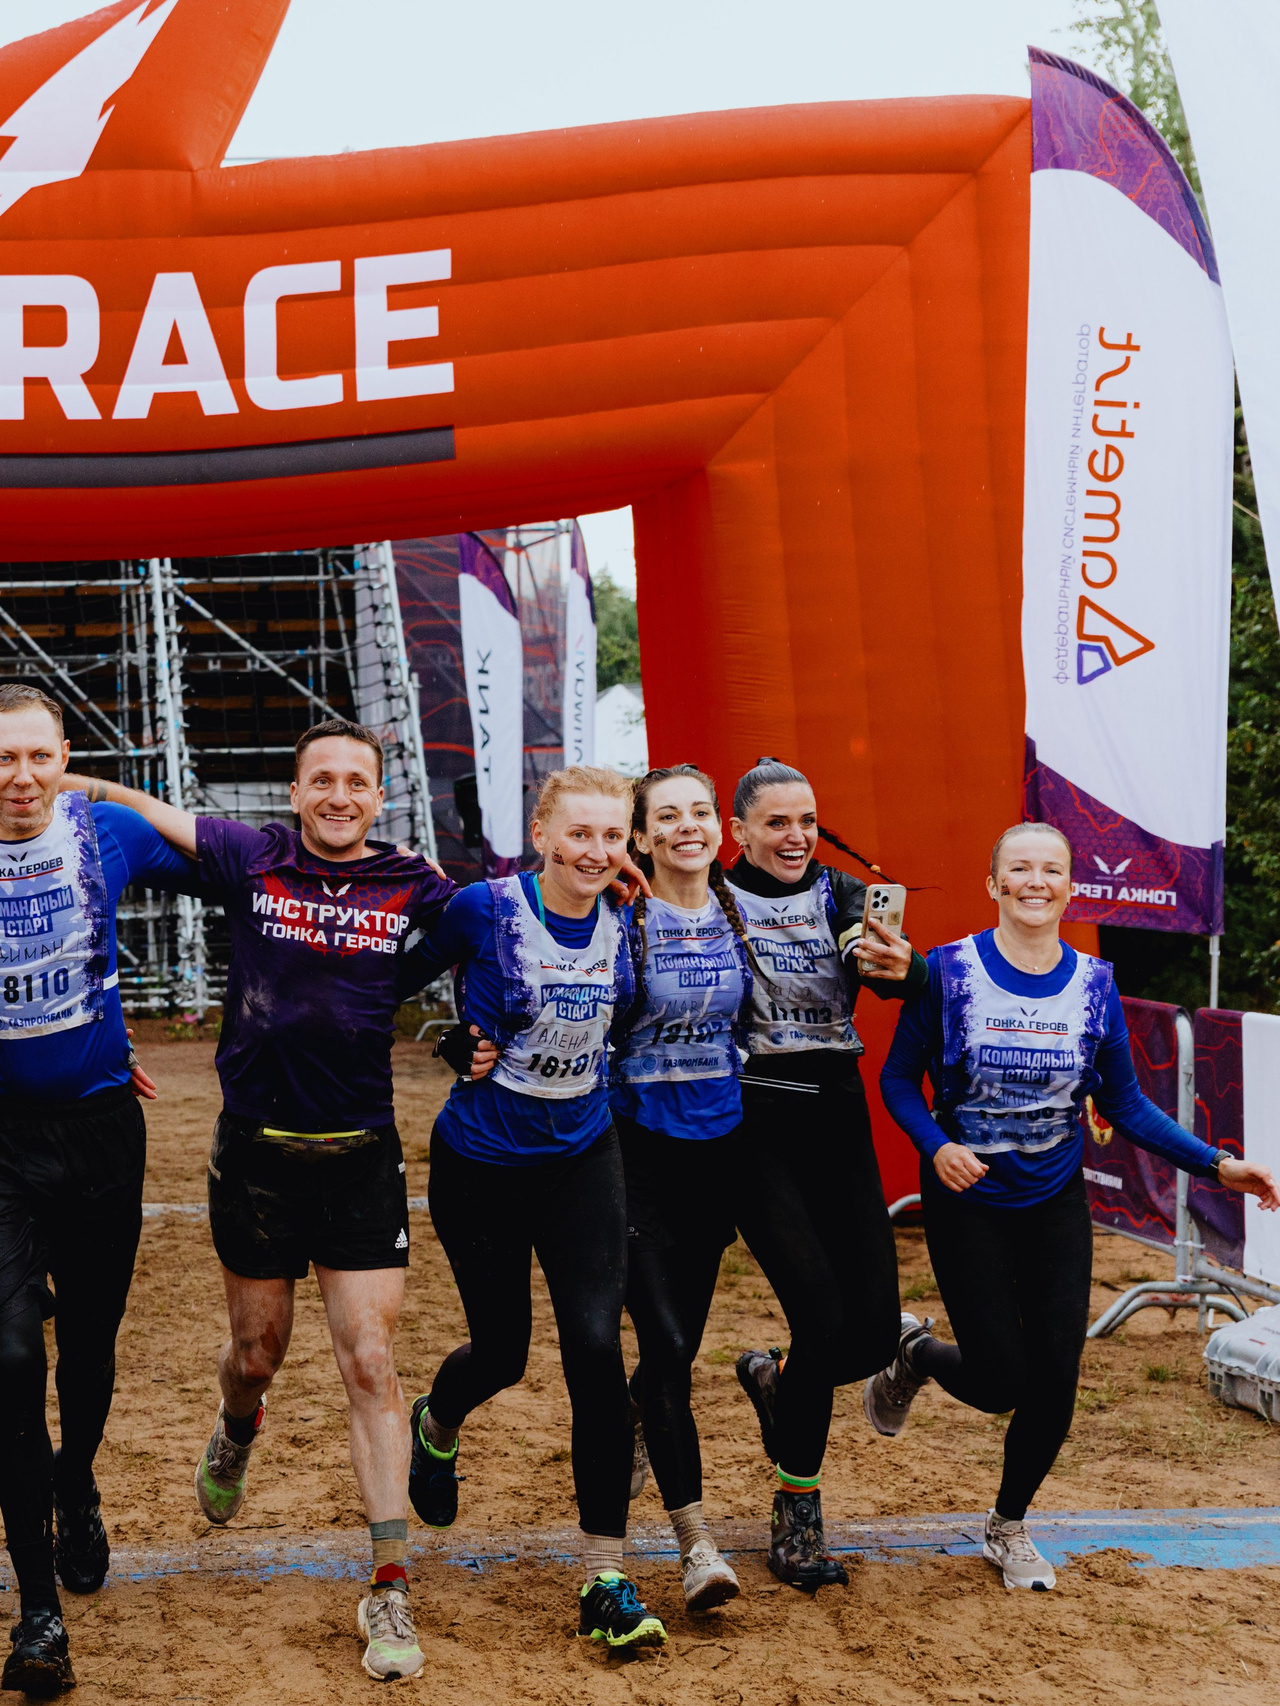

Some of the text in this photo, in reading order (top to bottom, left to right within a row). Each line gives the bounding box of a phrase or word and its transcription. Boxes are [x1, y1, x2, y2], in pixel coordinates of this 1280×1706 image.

[19, 856, 64, 876] ГЕРОЕВ
[252, 891, 410, 936] ИНСТРУКТОР
[6, 915, 50, 936] СТАРТ
[656, 928, 693, 939] ГОНКА
[261, 921, 398, 955] ГОНКА ГЕРОЕВ
[656, 949, 735, 971] КОМАНДНЫЙ
[775, 956, 815, 972] СТАРТ
[680, 970, 718, 987] СТАРТ
[8, 1006, 73, 1029] ГАЗПРОМБАНК
[558, 1000, 595, 1020] СТАРТ
[986, 1017, 1068, 1032] ГОНКА ГЕРОЕВ
[537, 1027, 590, 1051] АЛЕНА
[981, 1048, 1074, 1070] КОМАНДНЫЙ
[1005, 1069, 1048, 1083] СТАРТ
